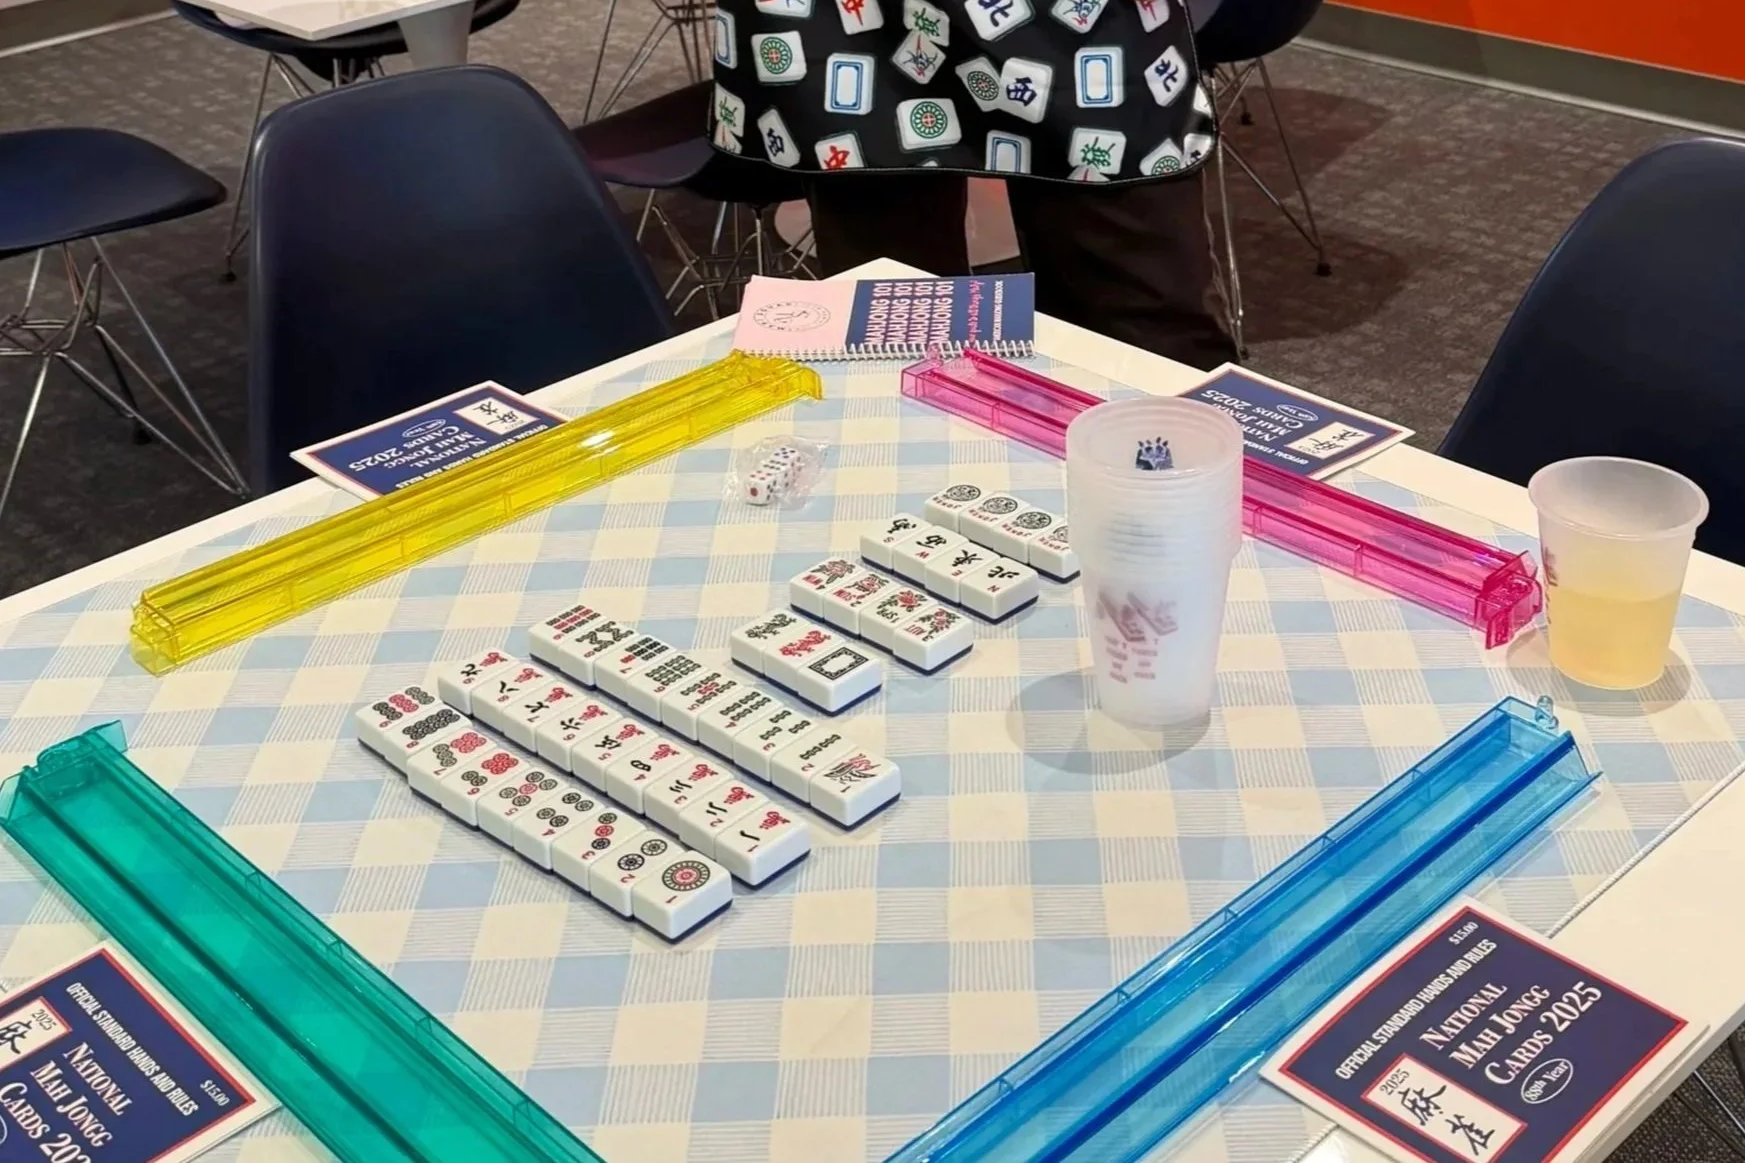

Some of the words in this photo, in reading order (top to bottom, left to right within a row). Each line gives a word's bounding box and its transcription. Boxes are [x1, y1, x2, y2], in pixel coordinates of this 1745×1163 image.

[872, 282, 893, 297] 101
[893, 282, 914, 296] 101
[913, 282, 934, 296] 101
[935, 281, 954, 295] 101
[864, 298, 890, 344] MAHJONG
[885, 298, 911, 344] MAHJONG
[906, 298, 932, 343] MAHJONG
[928, 297, 953, 343] MAHJONG
[1200, 389, 1252, 410] 2025
[1252, 406, 1304, 429] CARDS
[1258, 418, 1293, 436] MAH
[403, 425, 460, 449] CARDS
[439, 431, 475, 449] MAH
[348, 447, 404, 472] 2025
[410, 437, 487, 468] NATIONAL
[1449, 921, 1479, 945] $15.00
[31, 1009, 57, 1031] 2025
[1335, 1040, 1382, 1080] OFFICIAL
[1372, 999, 1425, 1043] STANDARD
[1416, 973, 1454, 1004] HANDS
[1446, 959, 1472, 979] AND
[1463, 939, 1497, 964] RULES
[1419, 982, 1508, 1051] NATIONAL
[1449, 1028, 1504, 1070] MAH
[1489, 985, 1550, 1035] JONGG
[1484, 1029, 1553, 1084] CARDS
[1540, 981, 1602, 1032] 2025
[66, 982, 102, 1016] OFFICIAL
[93, 1007, 137, 1052] STANDARD
[126, 1046, 160, 1078] HANDS
[150, 1071, 176, 1093] AND
[165, 1087, 199, 1117] RULES
[62, 1042, 133, 1116] NATIONAL
[1379, 1067, 1410, 1096] 2025
[1543, 1061, 1569, 1082] Year
[29, 1060, 73, 1103] MAH
[56, 1095, 113, 1147] JONGG
[200, 1079, 230, 1107] $15.00
[0, 1082, 50, 1139] CARDS
